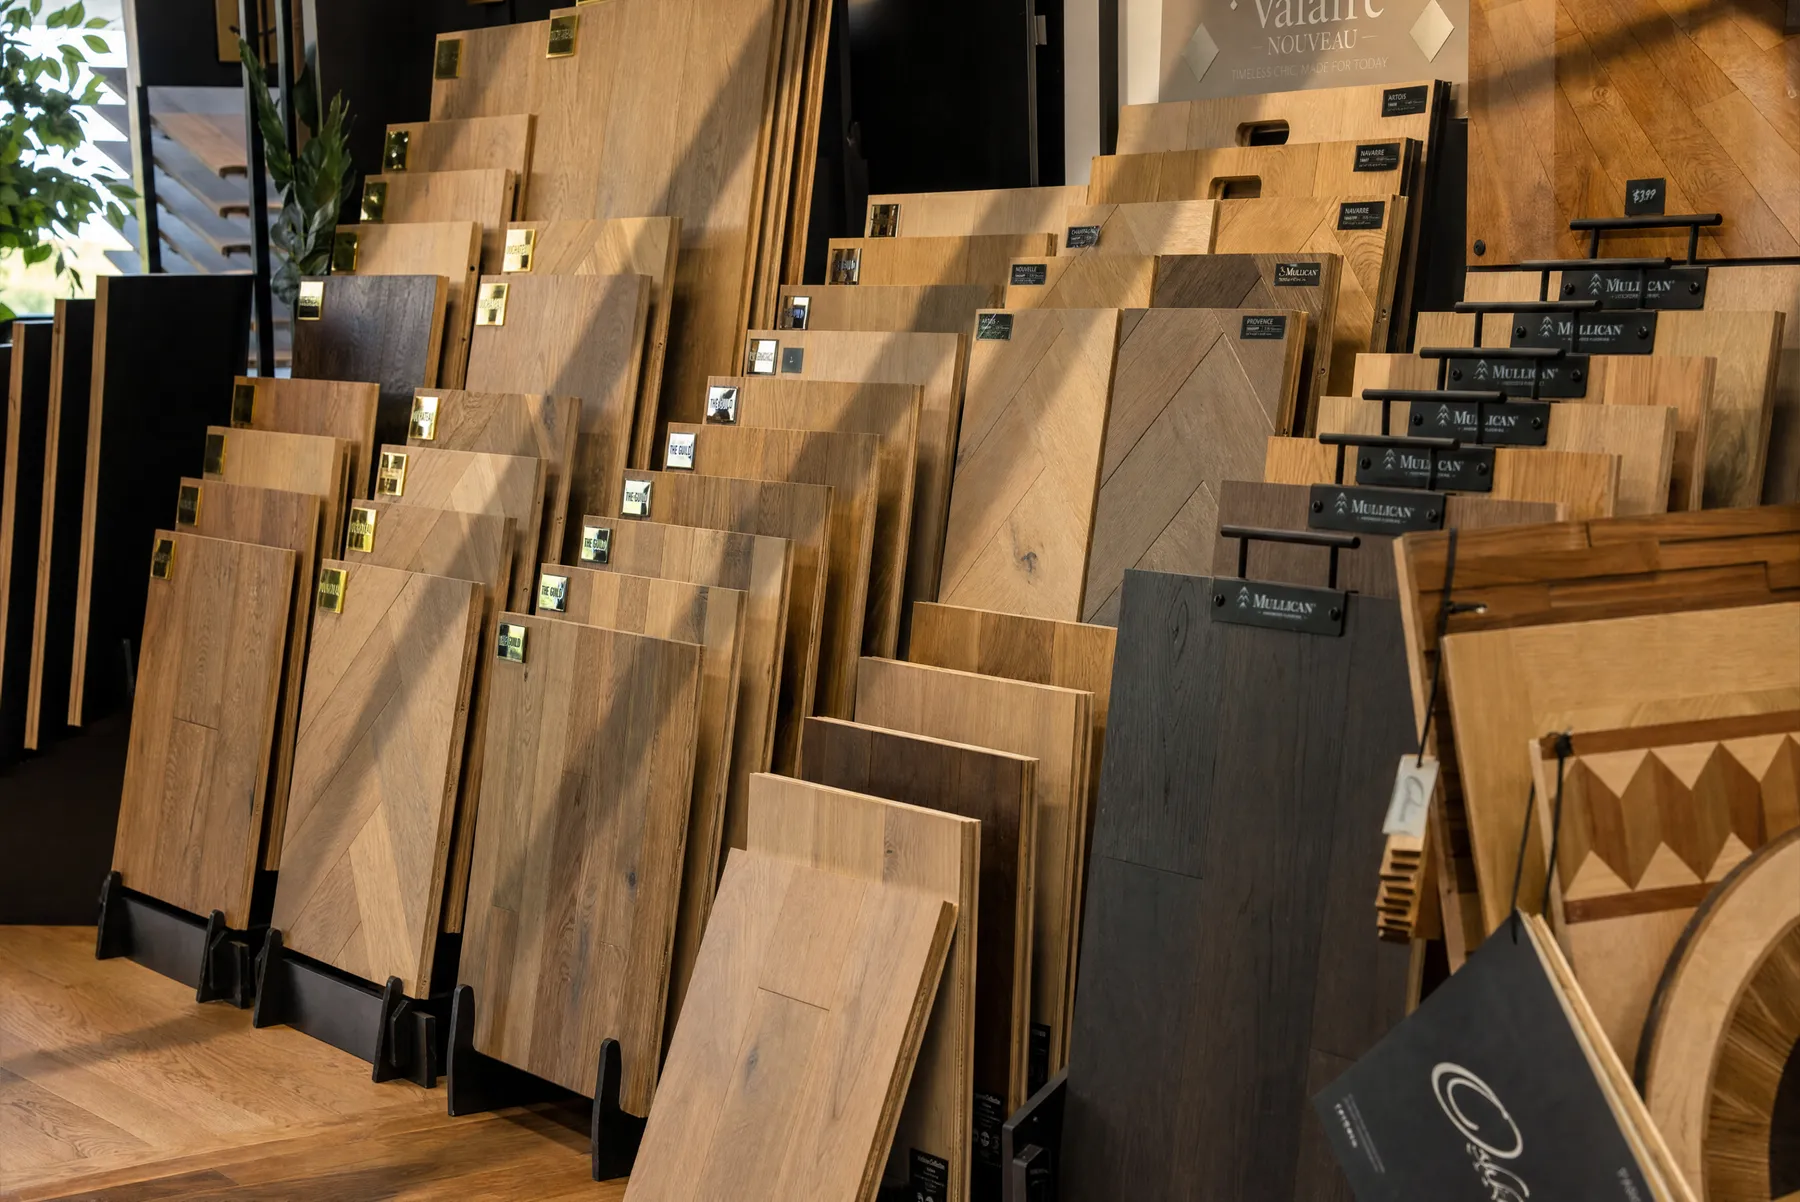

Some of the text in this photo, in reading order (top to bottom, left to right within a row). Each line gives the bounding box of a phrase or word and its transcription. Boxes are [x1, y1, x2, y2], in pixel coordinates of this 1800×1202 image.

[1268, 29, 1358, 56] NOUVEAU
[1231, 66, 1271, 80] TIMELESS
[1301, 62, 1329, 75] MADE
[1332, 60, 1351, 72] FOR
[1353, 57, 1389, 70] TODAY
[1632, 189, 1657, 204] $3.99
[1285, 267, 1318, 276] MULLICAN
[1351, 499, 1412, 518] MULLICAN
[1252, 593, 1313, 613] MULLICAN
